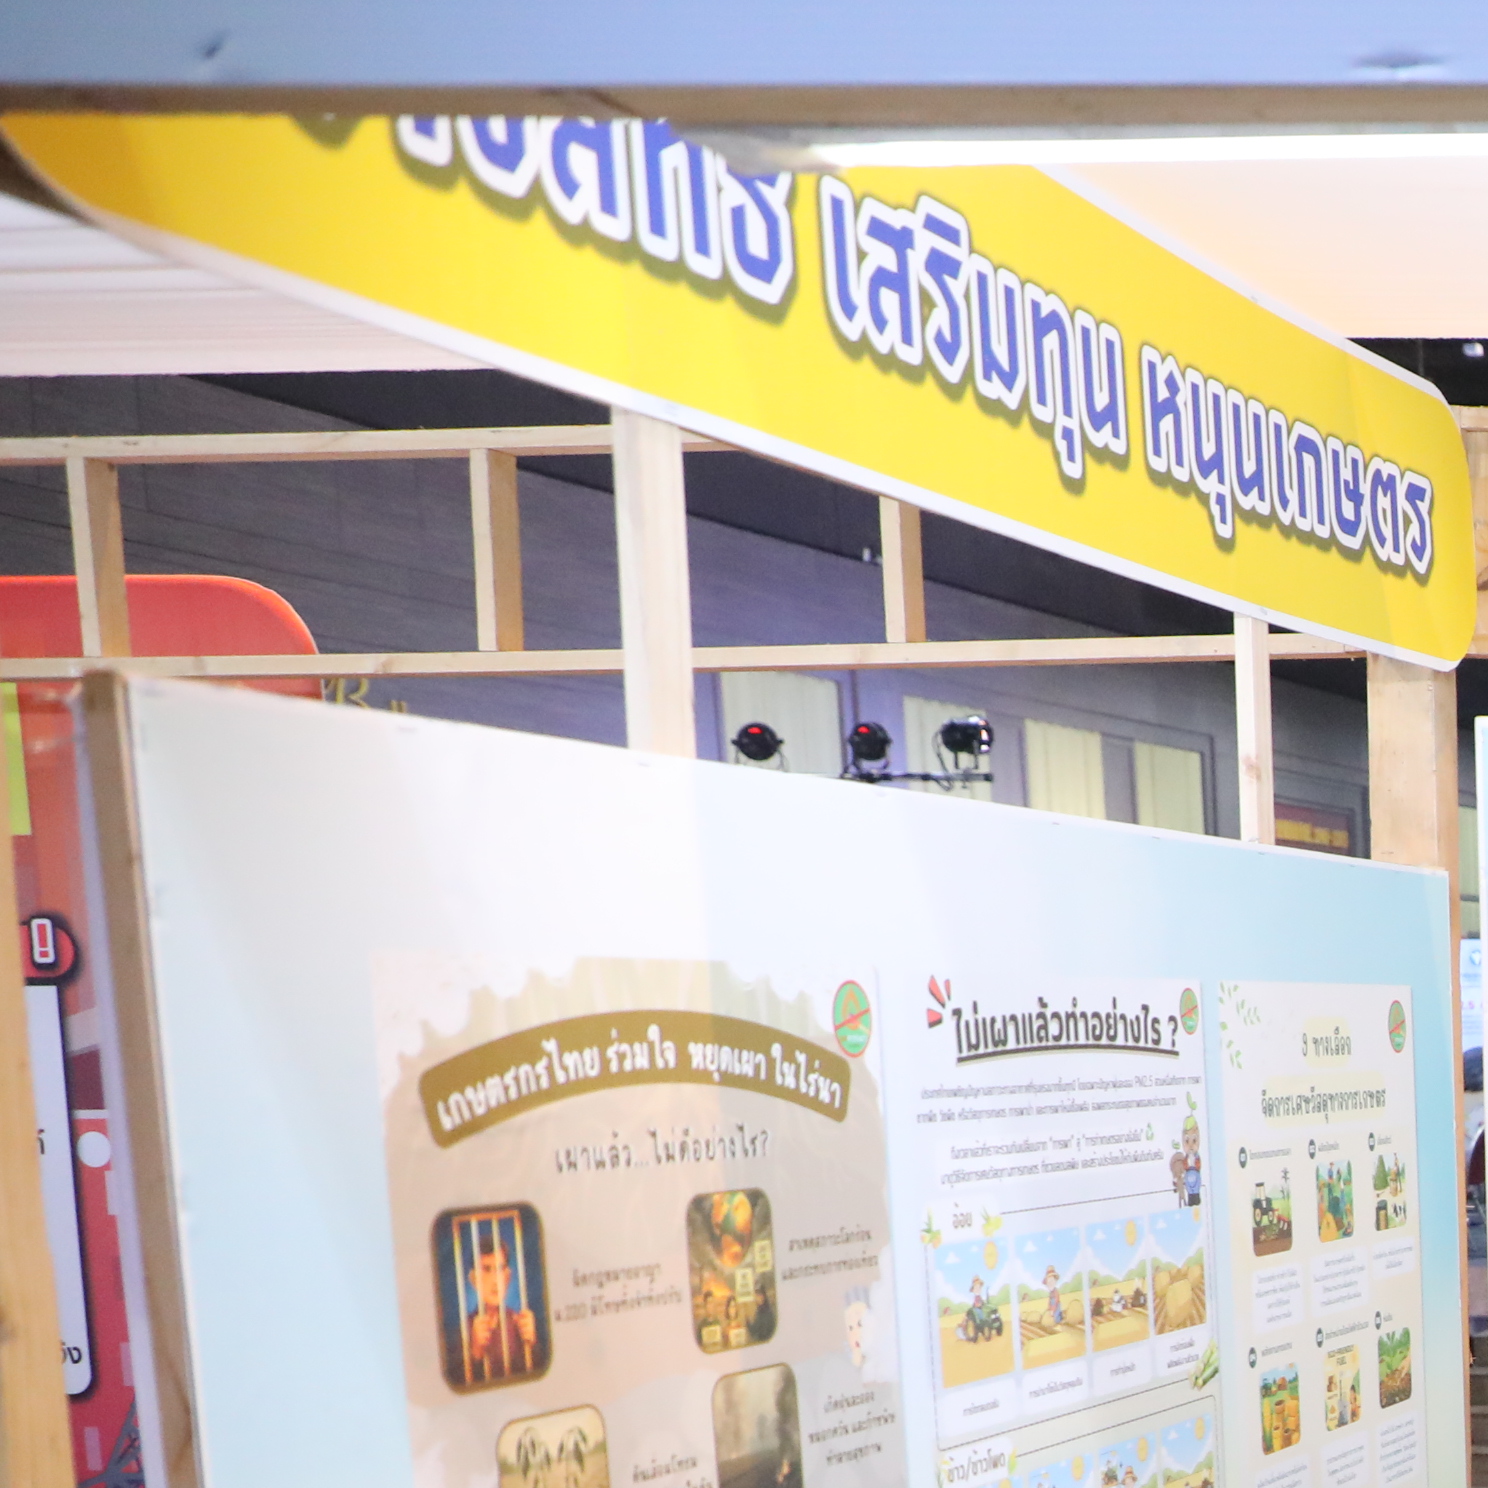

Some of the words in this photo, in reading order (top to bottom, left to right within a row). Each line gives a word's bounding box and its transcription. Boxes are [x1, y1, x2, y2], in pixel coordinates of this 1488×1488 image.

[822, 177, 1124, 477] เสริมทุน
[1142, 346, 1431, 573] หนุนเกษตร
[952, 996, 1162, 1054] ไม่เผาแล้วทำอย่างไร
[1168, 1016, 1178, 1048] ?
[437, 1039, 601, 1132] เกษตรกรไทย
[606, 1025, 676, 1073] ร่วมใจ
[687, 1042, 767, 1082] หยุดเผา
[770, 1045, 842, 1109] ในไร่นา
[555, 1123, 769, 1174] เผาแล้ว...ไม่ดีอย่างไร?
